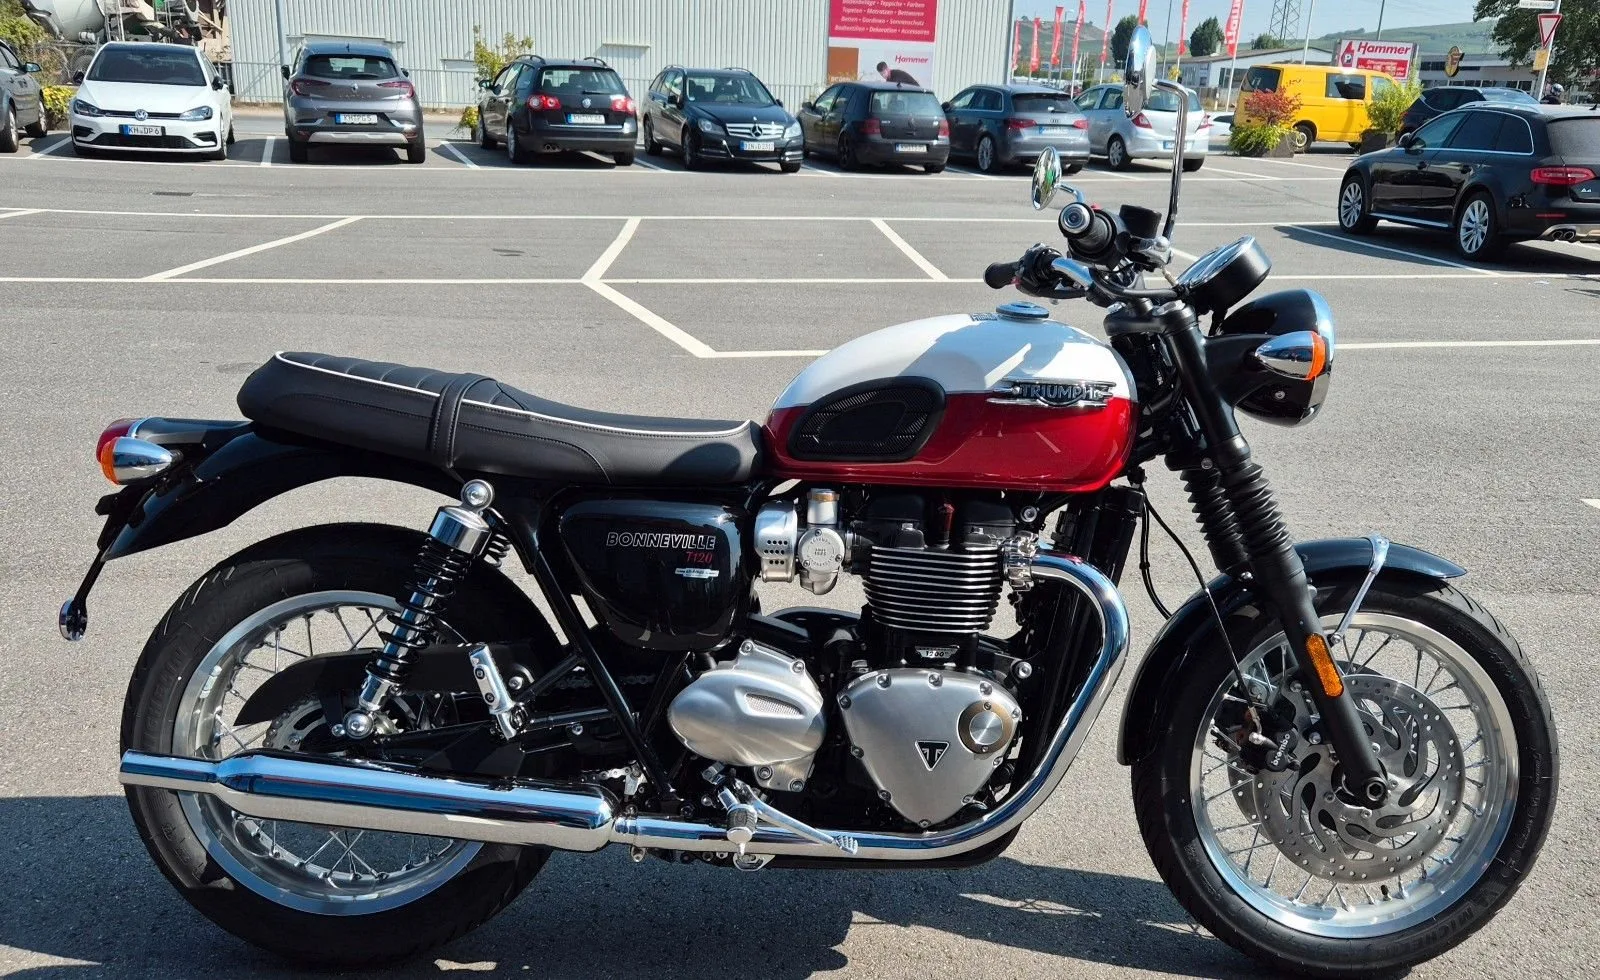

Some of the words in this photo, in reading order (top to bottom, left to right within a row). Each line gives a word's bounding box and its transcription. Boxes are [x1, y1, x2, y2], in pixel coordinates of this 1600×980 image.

[1358, 41, 1411, 55] Hammer
[895, 55, 928, 64] Hammer
[1021, 384, 1095, 400] TRIUMPH
[606, 532, 716, 550] BONNEVILLE
[686, 551, 713, 563] T120
[1270, 733, 1291, 767] brembo
